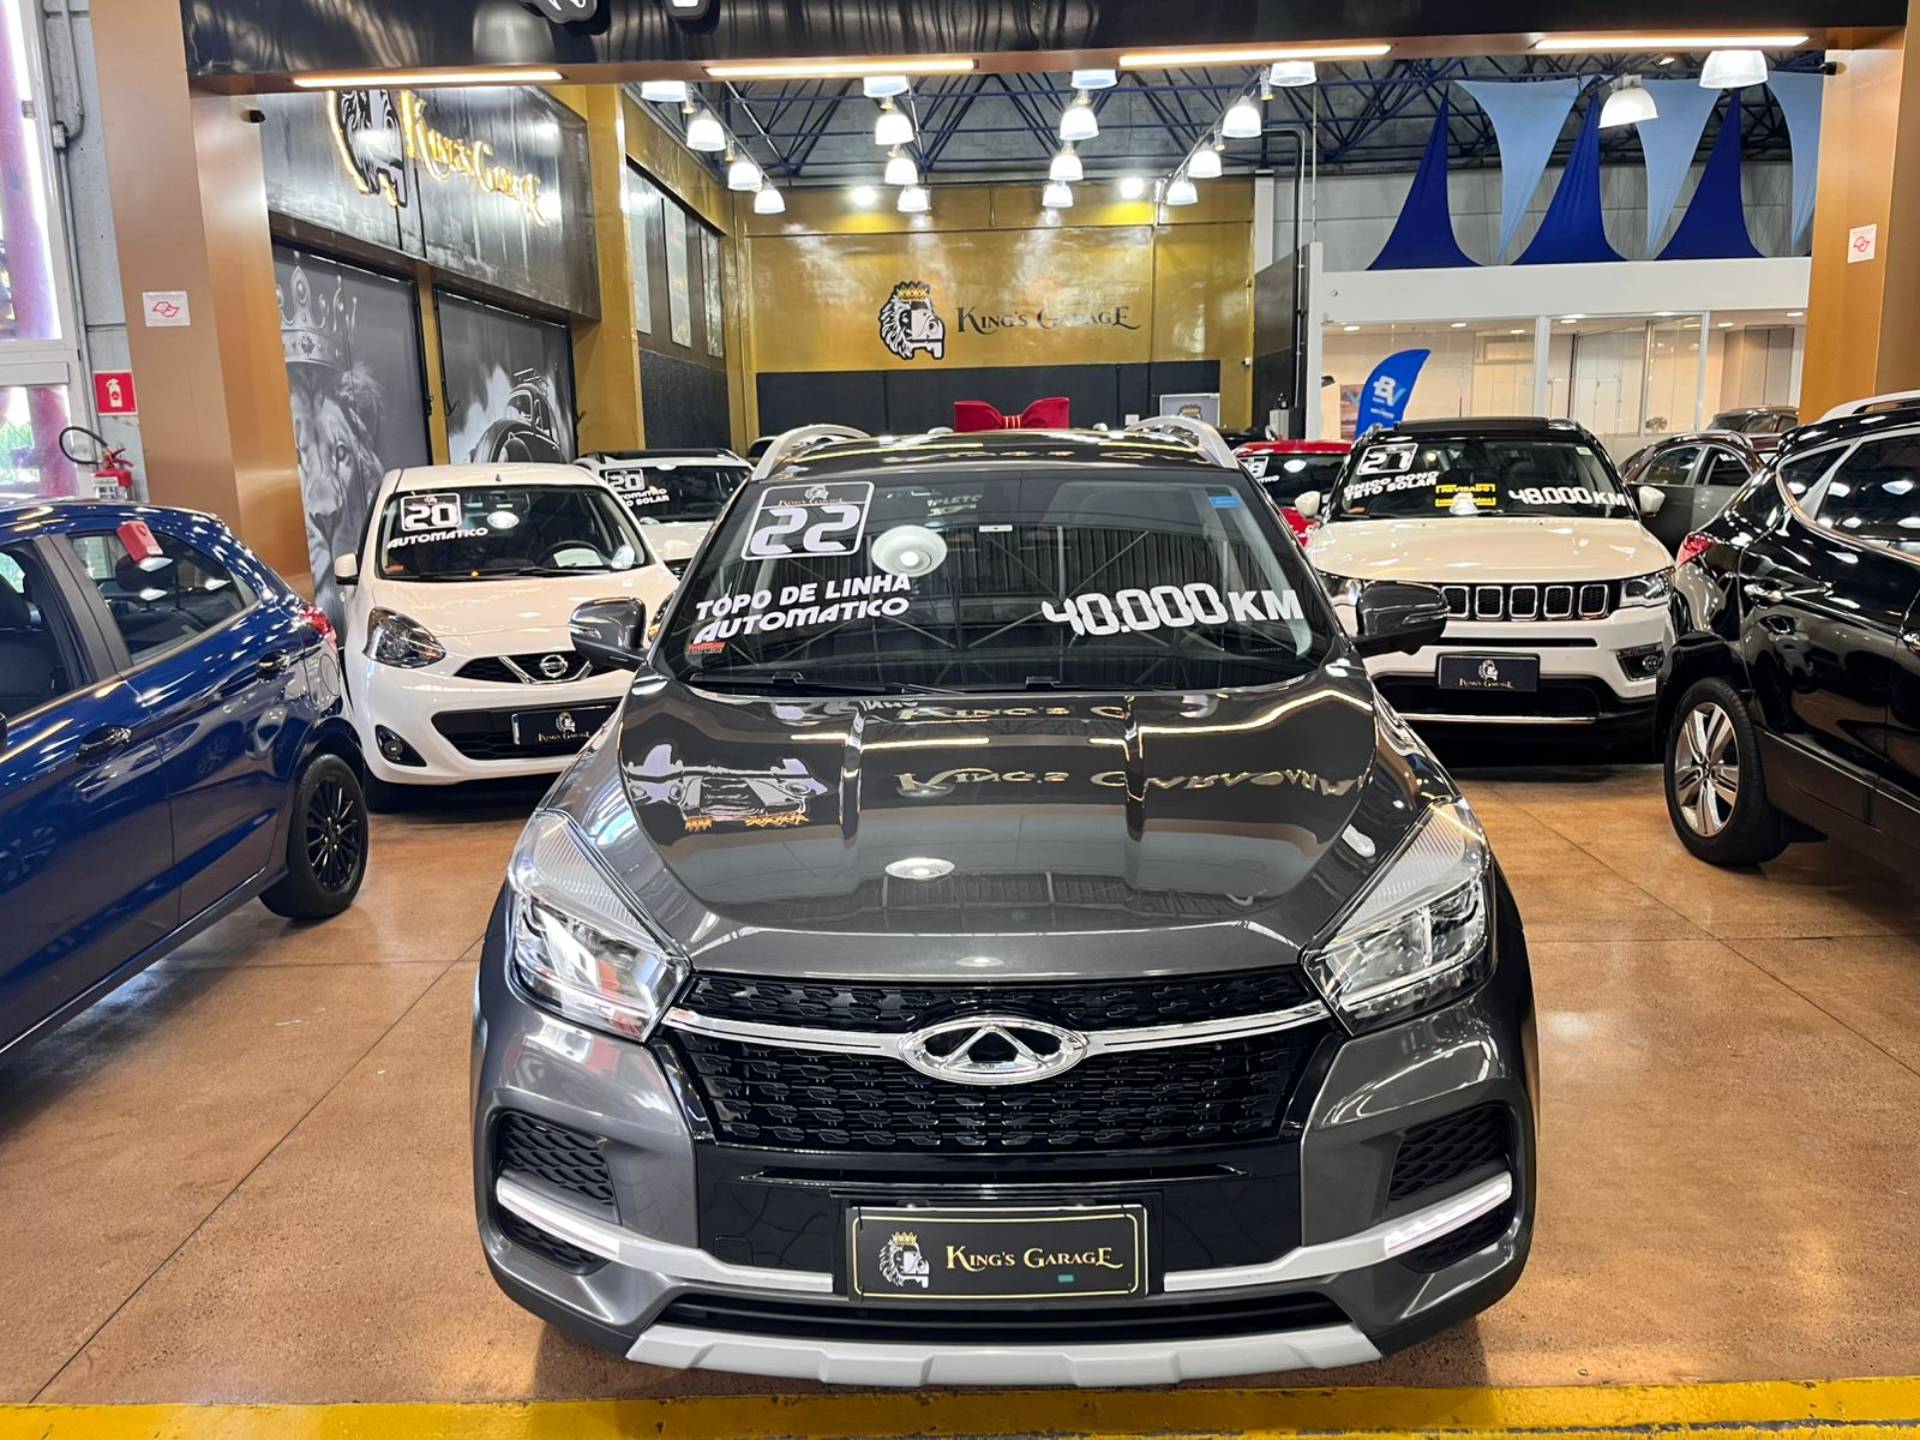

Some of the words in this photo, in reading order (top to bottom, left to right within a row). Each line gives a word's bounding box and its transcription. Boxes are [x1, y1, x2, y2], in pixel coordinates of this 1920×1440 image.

[956, 306, 1028, 336] KING'S
[609, 474, 642, 491] 20
[1593, 491, 1628, 506] KM
[405, 503, 459, 529] 20
[750, 504, 860, 555] 22
[387, 527, 488, 549] AUTOMATICO
[695, 589, 772, 620] TOPO
[779, 582, 818, 606] DE
[825, 573, 911, 600] LINHA
[693, 596, 910, 645] AUTOMATICO
[946, 1245, 1015, 1272] KING'S
[1024, 1247, 1124, 1269] GARAGE
